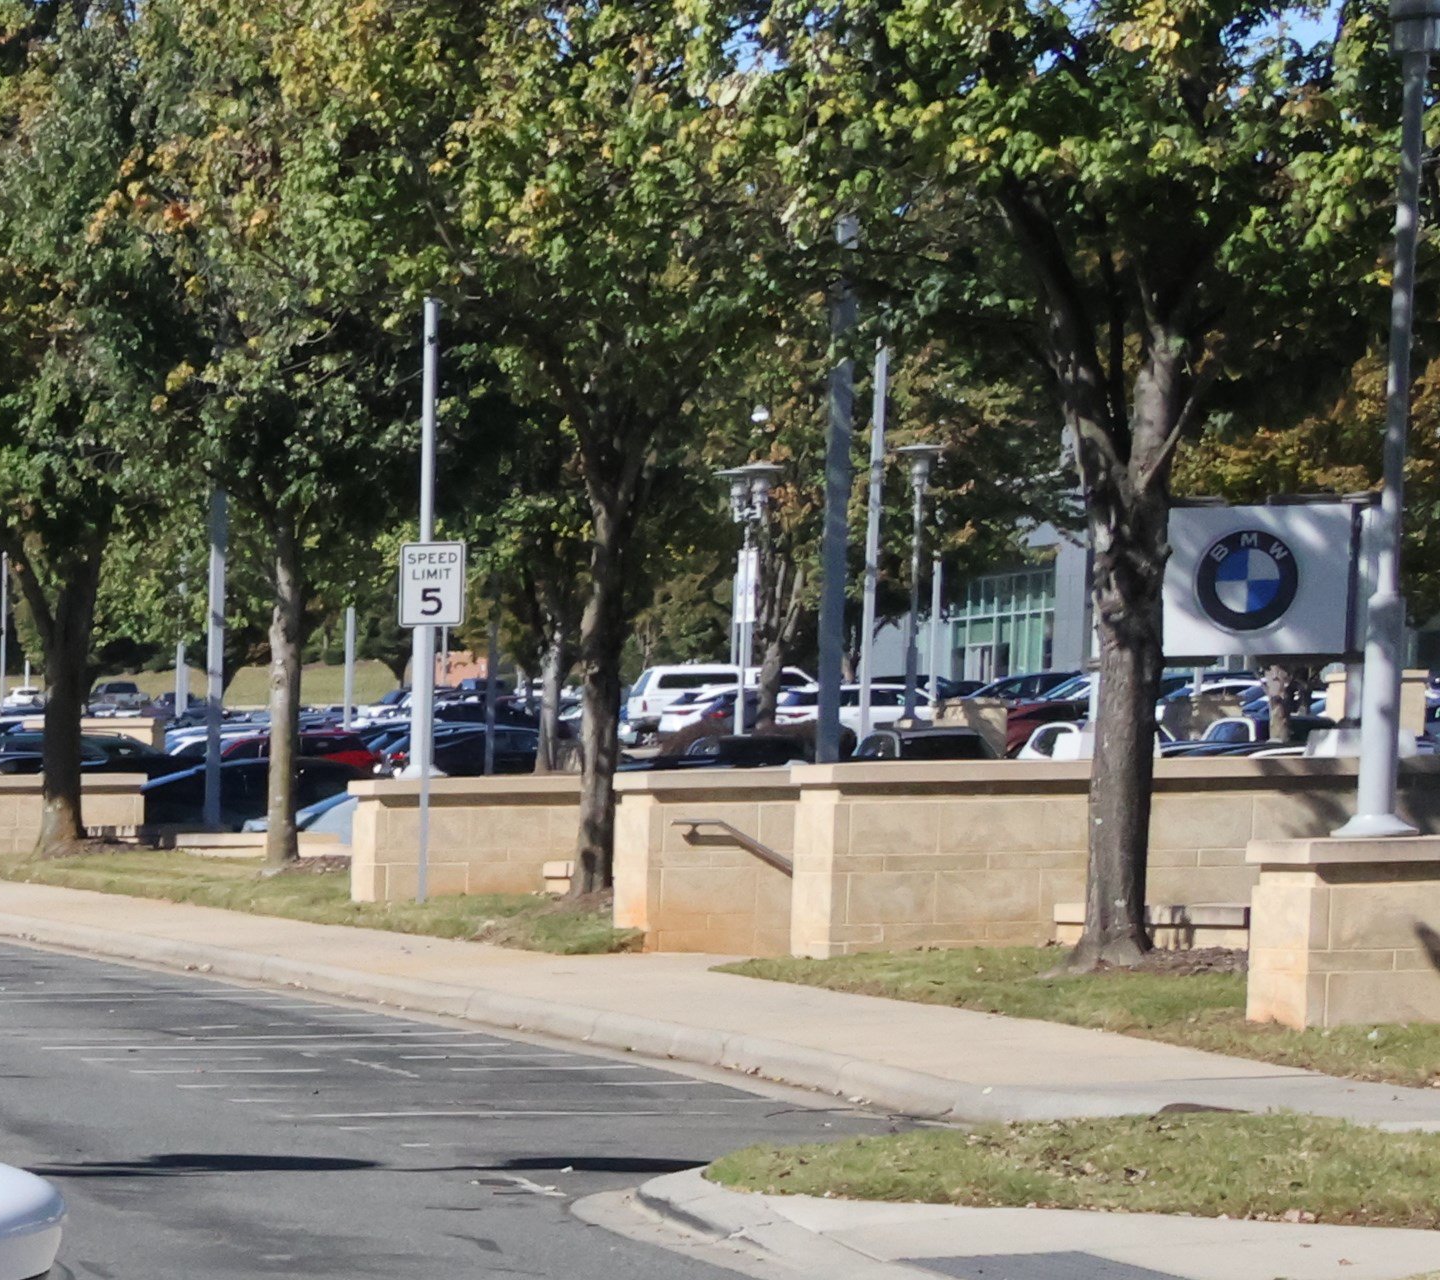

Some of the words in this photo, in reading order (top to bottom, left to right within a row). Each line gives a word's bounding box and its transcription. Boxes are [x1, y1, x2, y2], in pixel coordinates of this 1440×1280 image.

[407, 552, 458, 565] SPEED
[412, 568, 452, 580] LIMIT
[420, 588, 443, 616] 5
